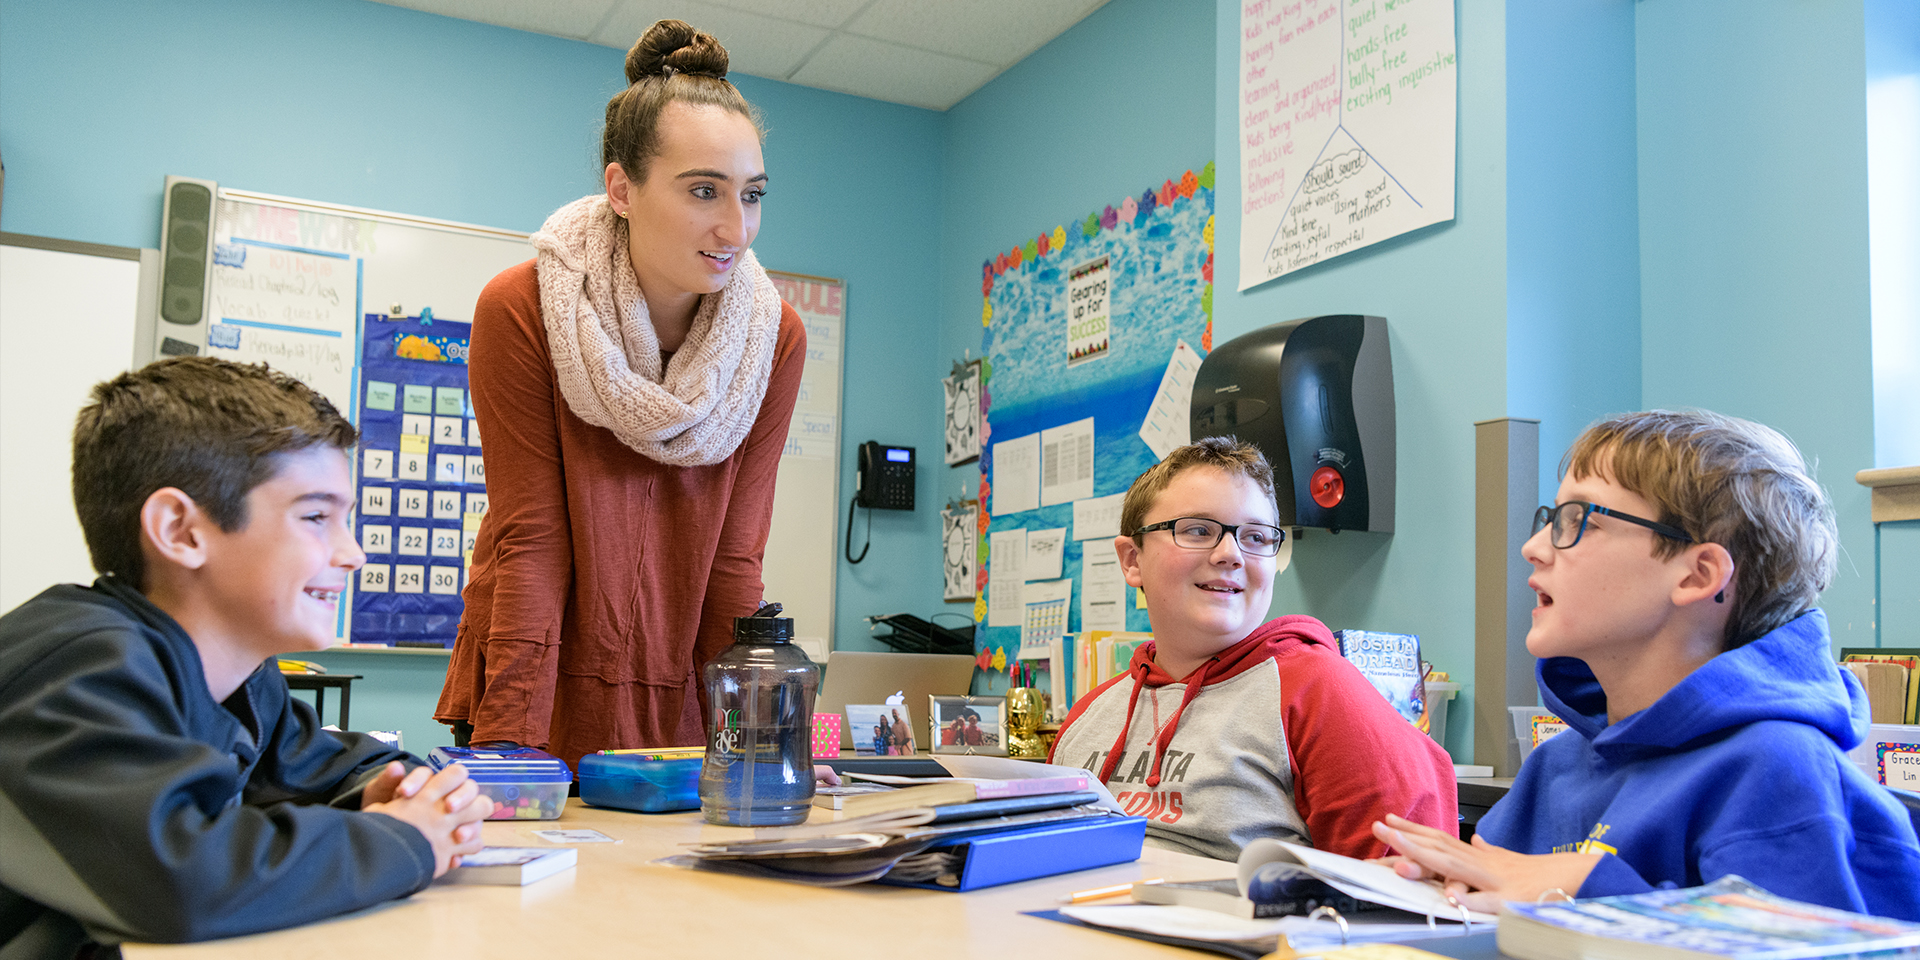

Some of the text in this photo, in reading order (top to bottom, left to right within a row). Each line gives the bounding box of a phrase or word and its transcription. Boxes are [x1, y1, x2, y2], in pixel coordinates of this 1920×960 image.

[1348, 0, 1376, 38] quiet
[1245, 41, 1274, 64] having
[1317, 3, 1337, 25] each
[1245, 79, 1280, 105] learning
[1347, 50, 1455, 112] exciting inquisitive
[1245, 109, 1269, 129] clean
[1274, 92, 1290, 114] and
[1248, 140, 1294, 171] inclusive
[1365, 176, 1387, 207] good
[1290, 188, 1340, 224] quiet voices
[1348, 194, 1392, 225] manners
[215, 198, 377, 254] HOMEWORK
[1301, 217, 1318, 233] tone
[1324, 226, 1365, 254] respectful
[1071, 280, 1107, 304] Gearing
[1073, 305, 1085, 322] up
[1070, 315, 1107, 342] SUCCESS
[444, 425, 452, 437] 2
[782, 438, 803, 456] ath
[374, 458, 485, 476] 7 8 9 10
[369, 495, 486, 513] 14 15 16 17
[370, 534, 475, 550] 21 22 23 2
[366, 572, 453, 587] 28 29 30
[1346, 634, 1416, 656] JOSHUA
[1353, 653, 1417, 672] DREAD
[812, 720, 831, 754] B
[1891, 752, 1920, 765] Grace
[1902, 770, 1917, 781] Lin
